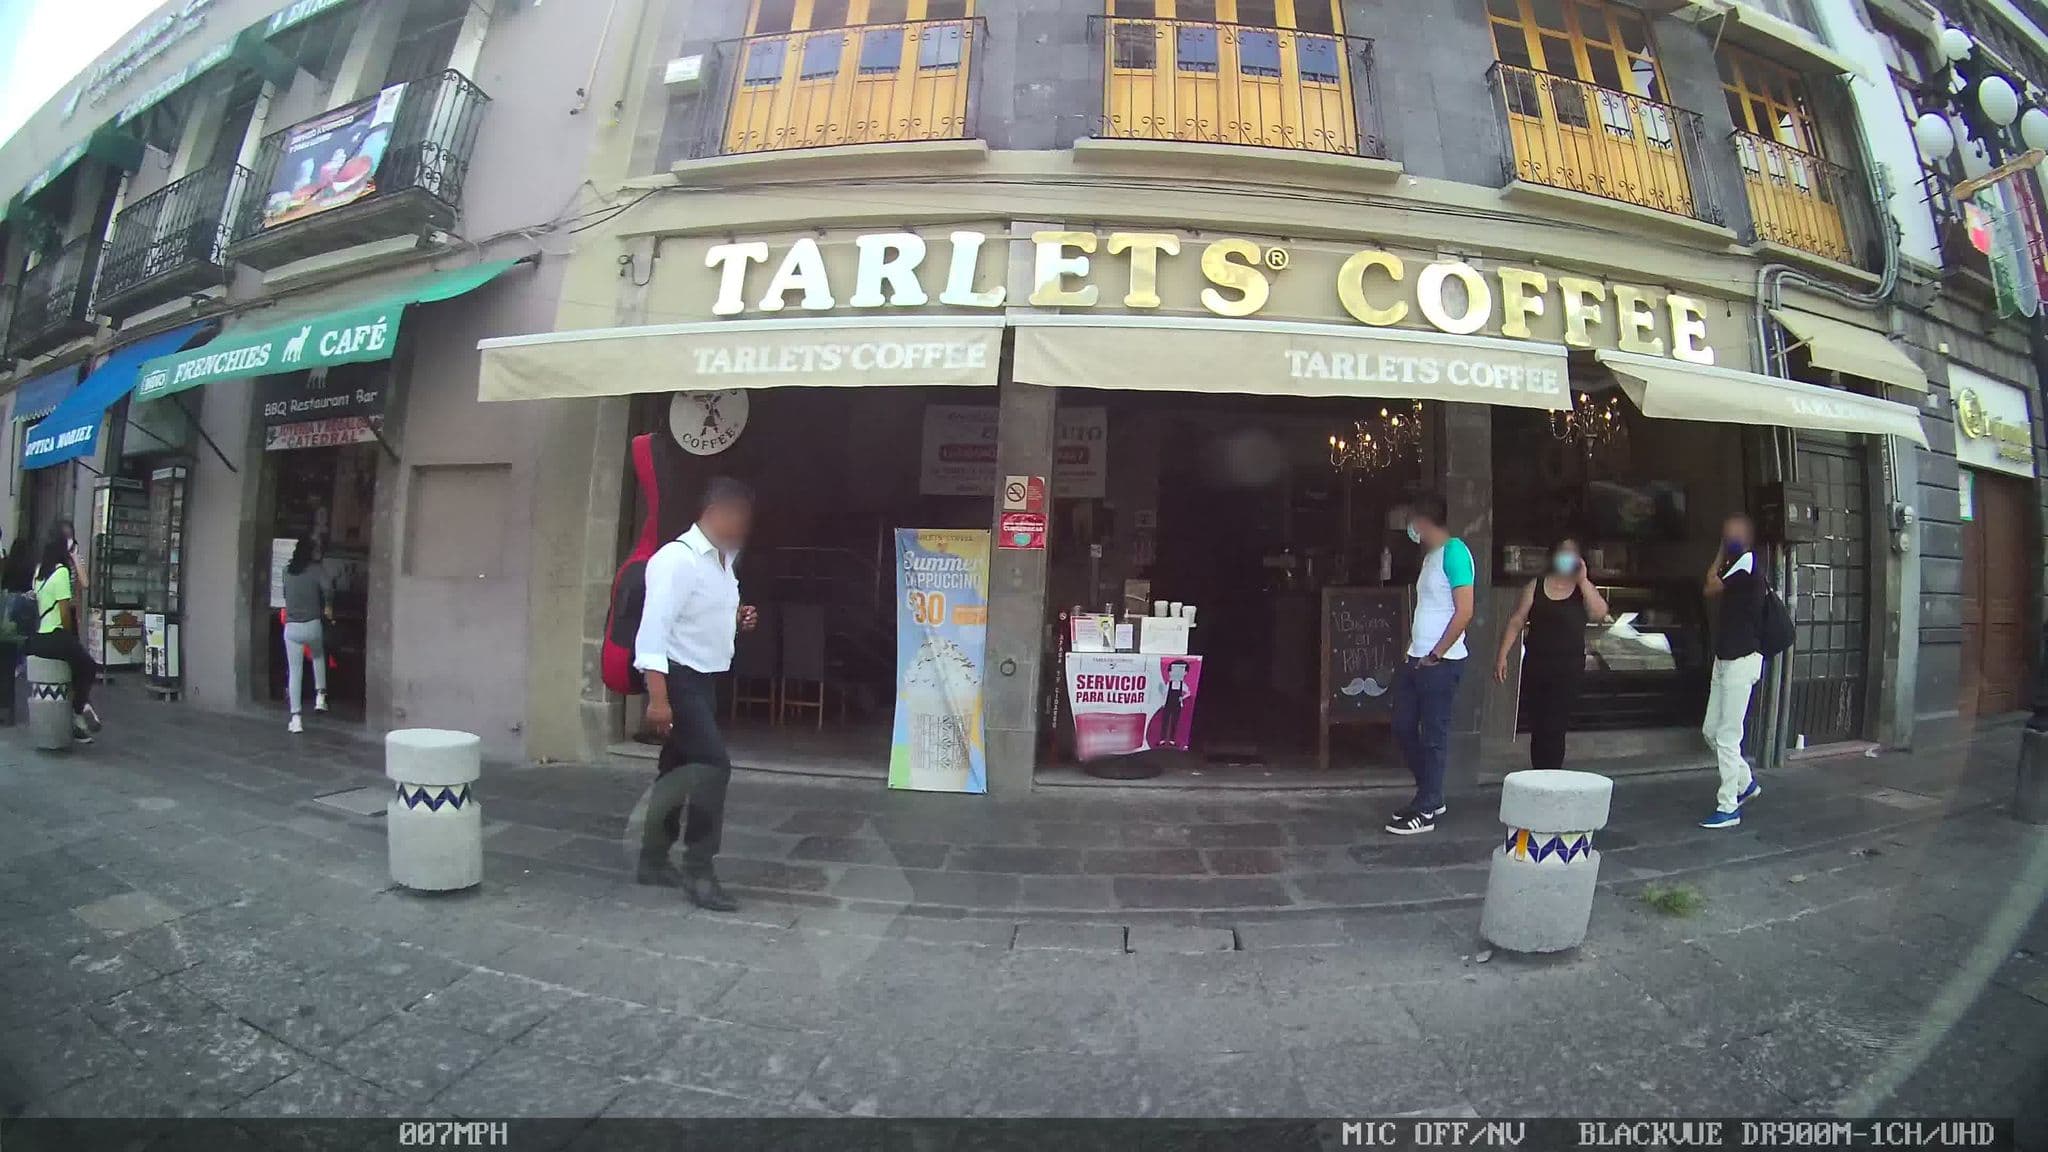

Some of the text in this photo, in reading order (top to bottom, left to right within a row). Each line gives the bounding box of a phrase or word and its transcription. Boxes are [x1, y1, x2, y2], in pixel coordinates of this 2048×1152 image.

[1337, 249, 1715, 365] COFFEE
[173, 316, 387, 384] FRENCHIES CAFÉ
[850, 341, 987, 370] COFFEE
[1447, 357, 1560, 395] COFFEE
[264, 388, 378, 417] BBQ Restaurant Bar
[683, 428, 736, 450] COFFEE
[903, 551, 983, 572] Summer
[904, 572, 983, 590] CAPPUCCINO
[1076, 674, 1147, 692] SERVICIO
[1075, 691, 1145, 704] PARA LLEVAR
